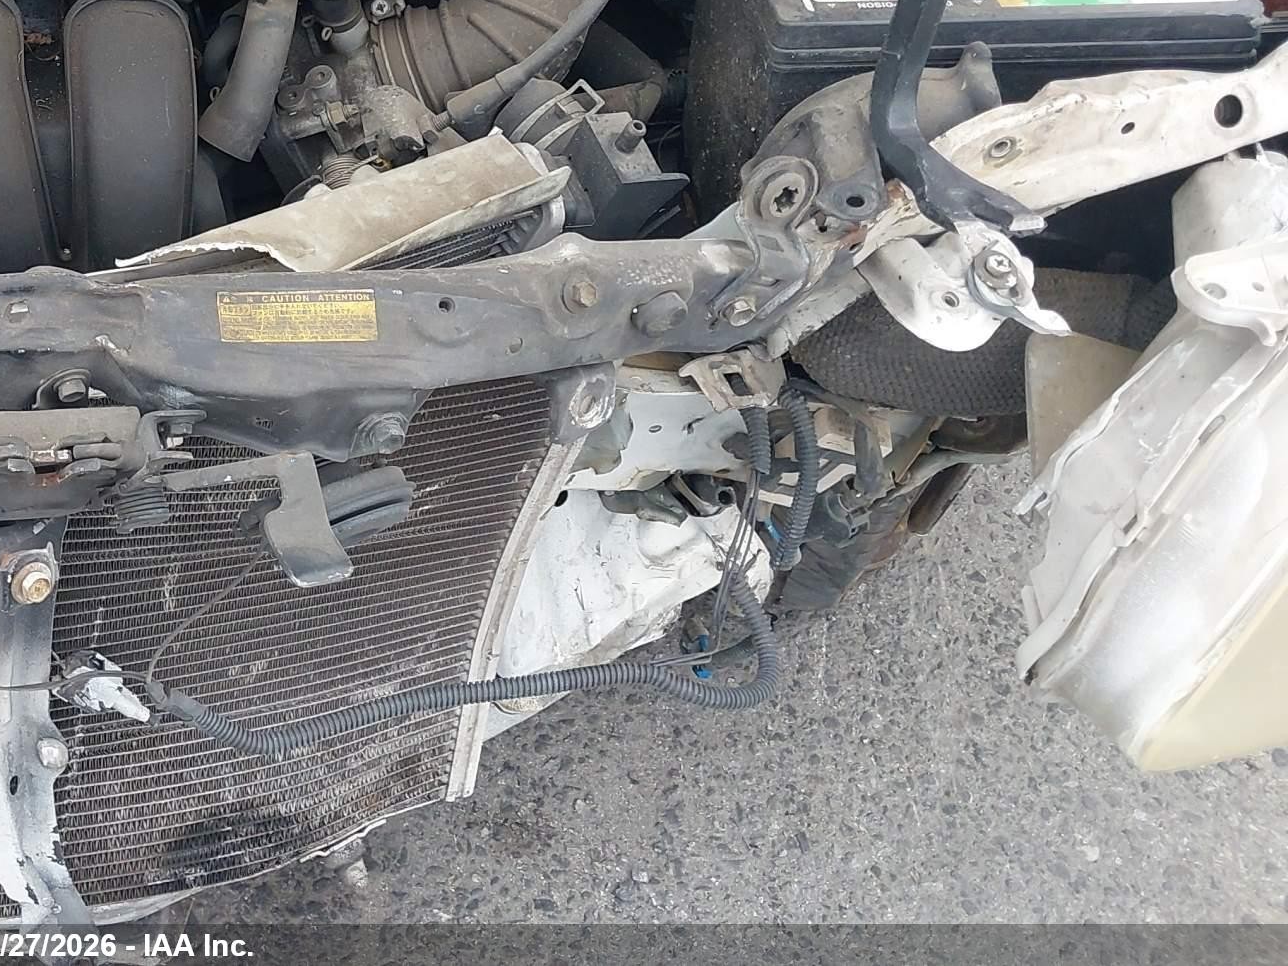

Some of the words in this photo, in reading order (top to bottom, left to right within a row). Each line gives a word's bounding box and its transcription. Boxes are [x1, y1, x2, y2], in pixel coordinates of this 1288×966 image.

[857, 0, 898, 10] OISON
[261, 293, 310, 303] CAUTION
[318, 292, 371, 303] ATTENTION
